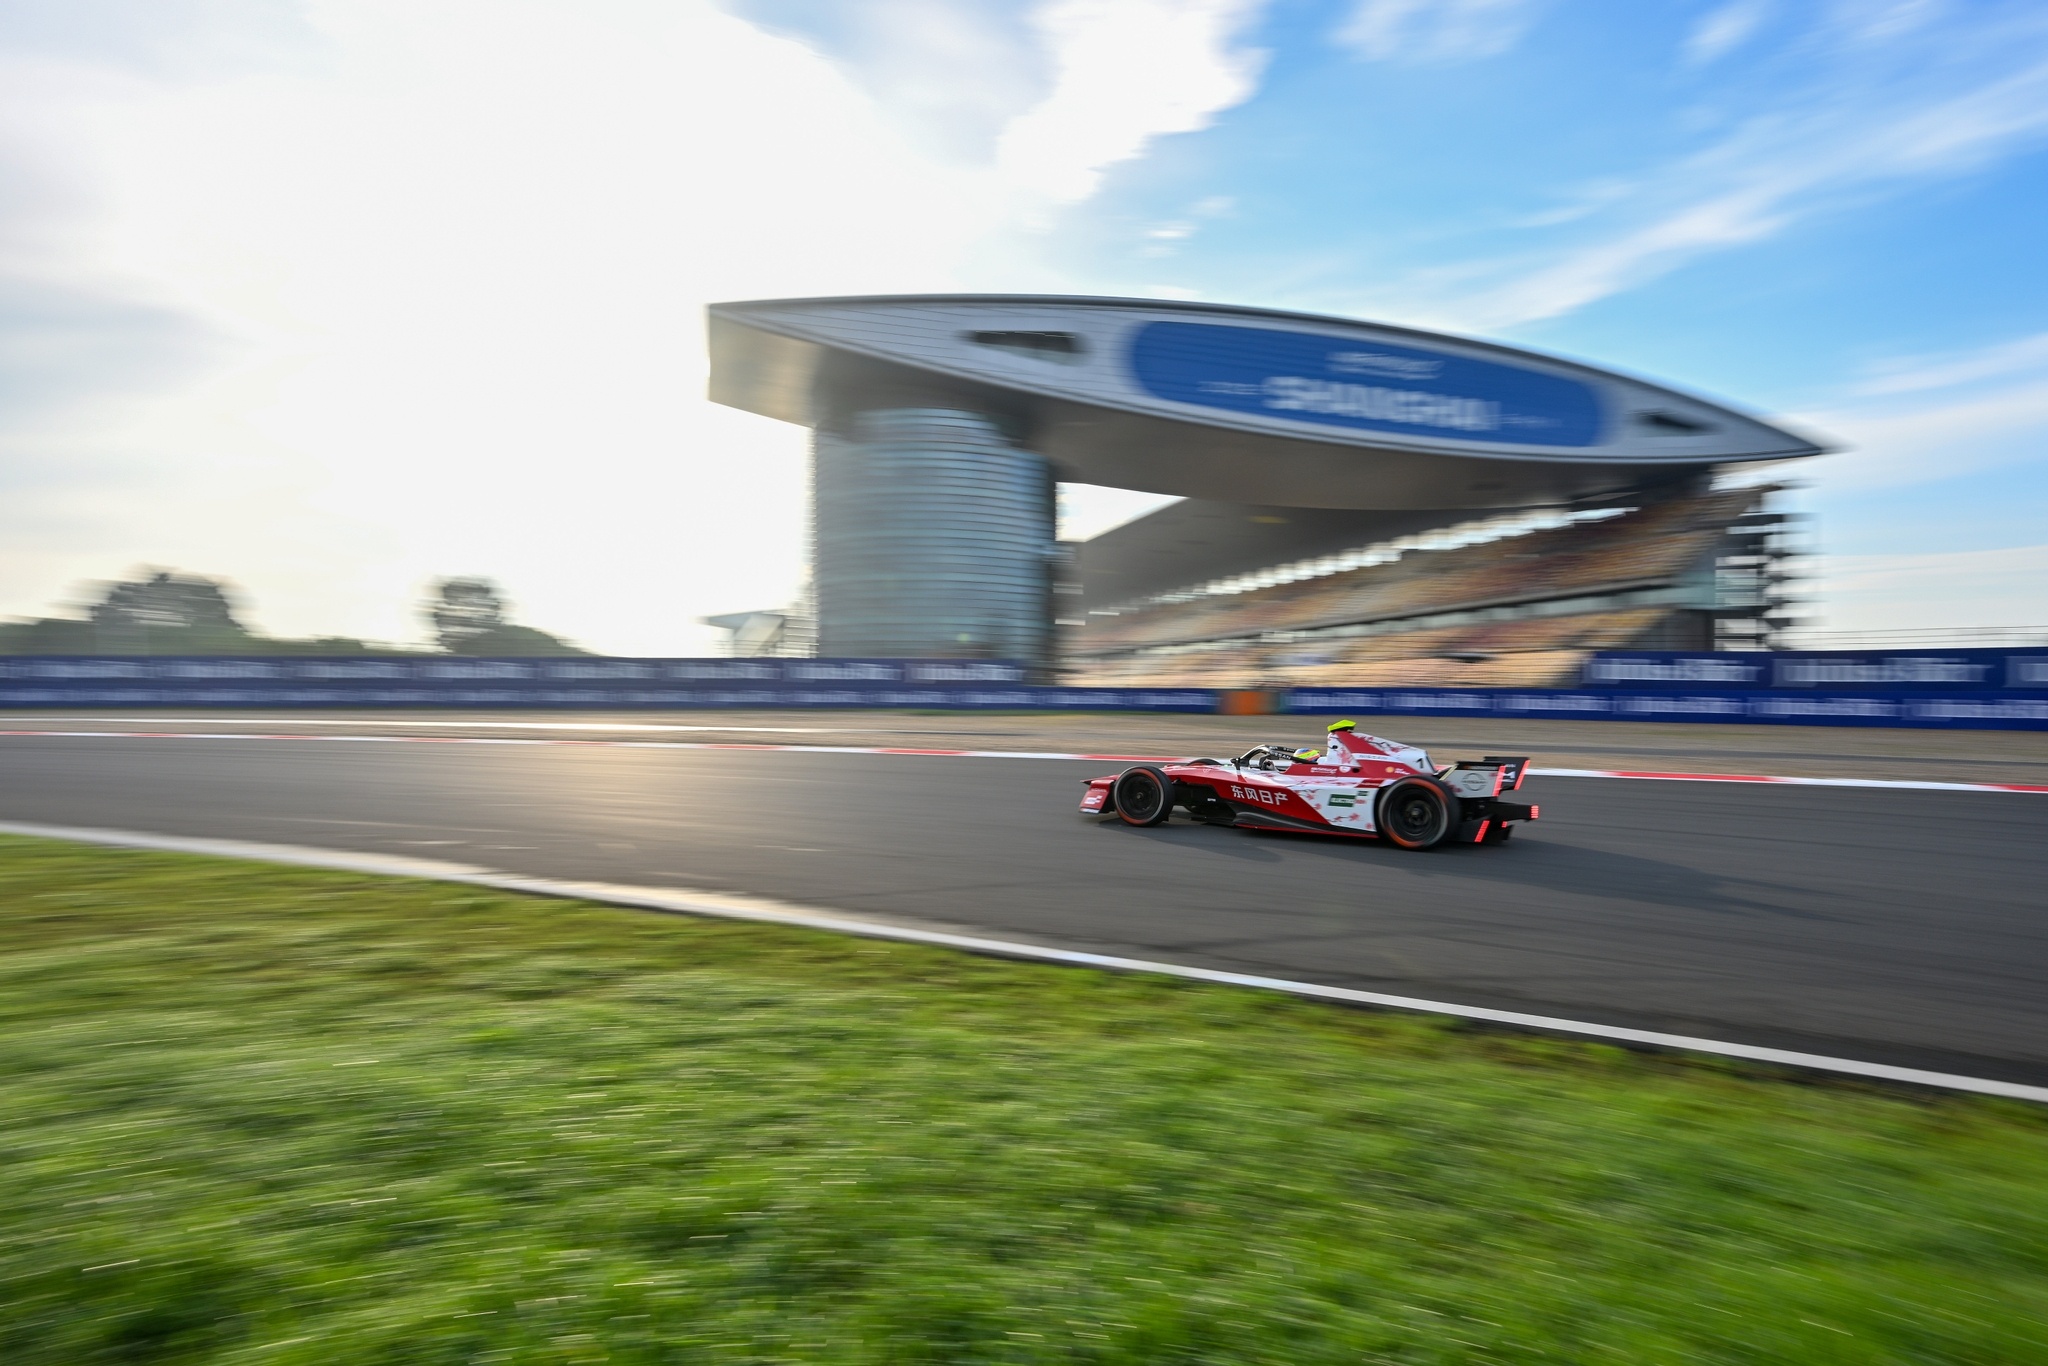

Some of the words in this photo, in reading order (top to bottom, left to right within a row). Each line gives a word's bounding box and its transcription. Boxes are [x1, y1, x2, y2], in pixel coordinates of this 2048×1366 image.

[1416, 757, 1424, 769] 1
[1230, 785, 1289, 806] 东风日产
